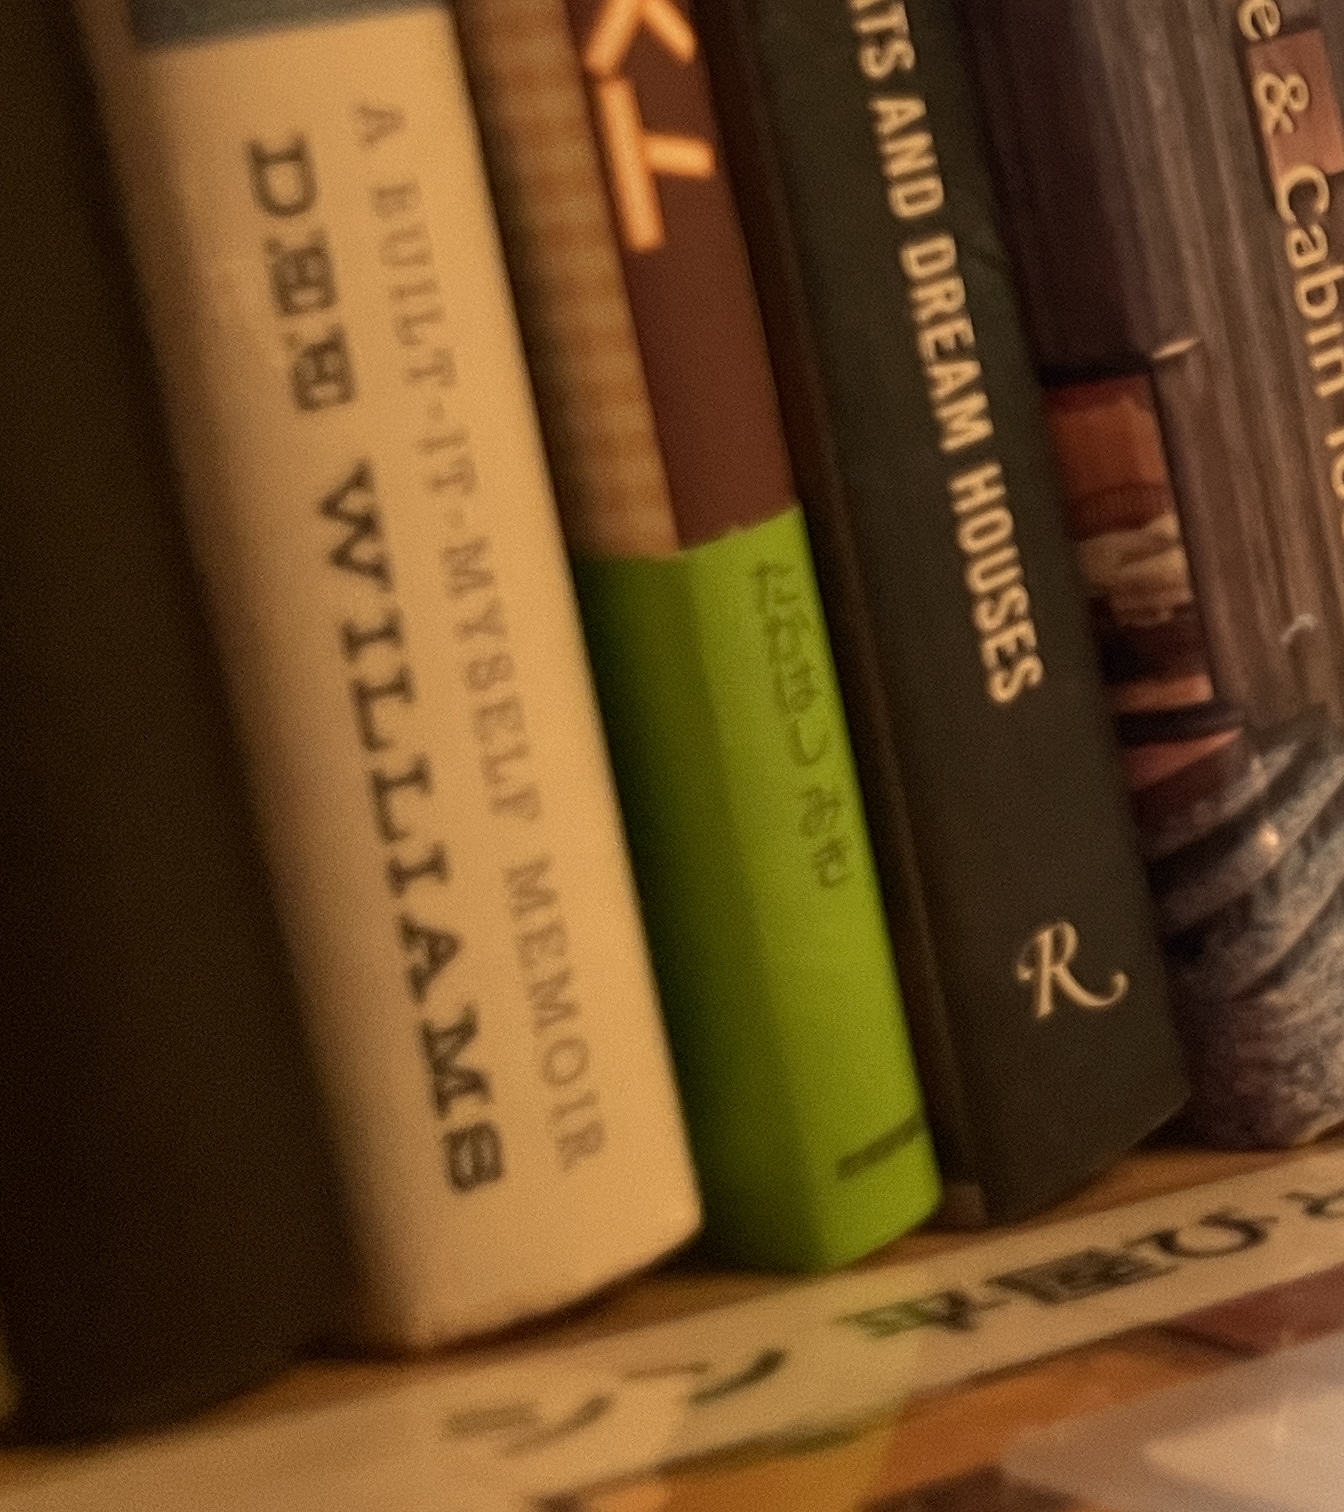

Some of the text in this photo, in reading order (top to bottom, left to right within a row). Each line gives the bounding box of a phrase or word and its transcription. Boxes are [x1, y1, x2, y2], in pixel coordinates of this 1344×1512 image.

[869, 96, 945, 219] AND
[1253, 70, 1310, 136] &
[901, 232, 995, 454] DREAM
[949, 462, 1045, 705] HOUSES
[316, 456, 507, 1194] WILLIAMS
[503, 851, 607, 1173] MEMOIR
[1017, 919, 1128, 1019] R
